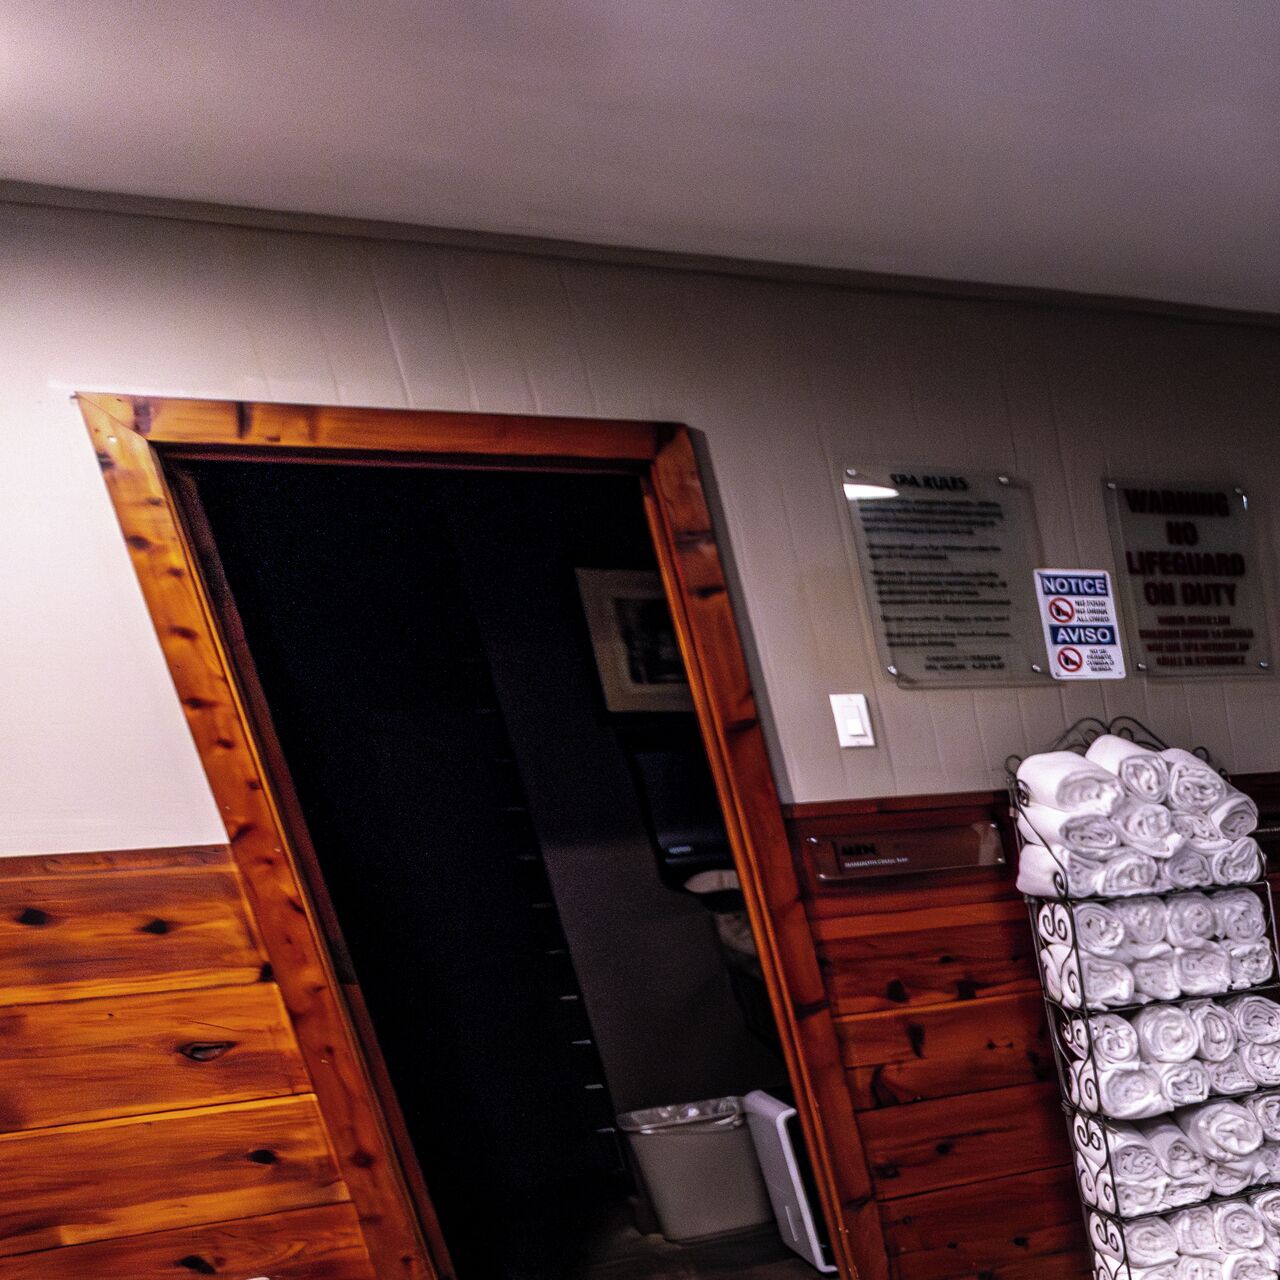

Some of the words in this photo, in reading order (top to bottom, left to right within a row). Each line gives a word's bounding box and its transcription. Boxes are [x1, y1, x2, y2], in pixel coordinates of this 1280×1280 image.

[922, 475, 968, 491] RULES
[1125, 488, 1230, 517] WARNING
[1166, 521, 1199, 546] NO
[1125, 550, 1246, 576] LIFEGUARD
[1043, 577, 1106, 594] NOTICE
[1144, 581, 1176, 606] ON
[1182, 582, 1236, 607] DUTY
[1056, 627, 1110, 643] AVISO
